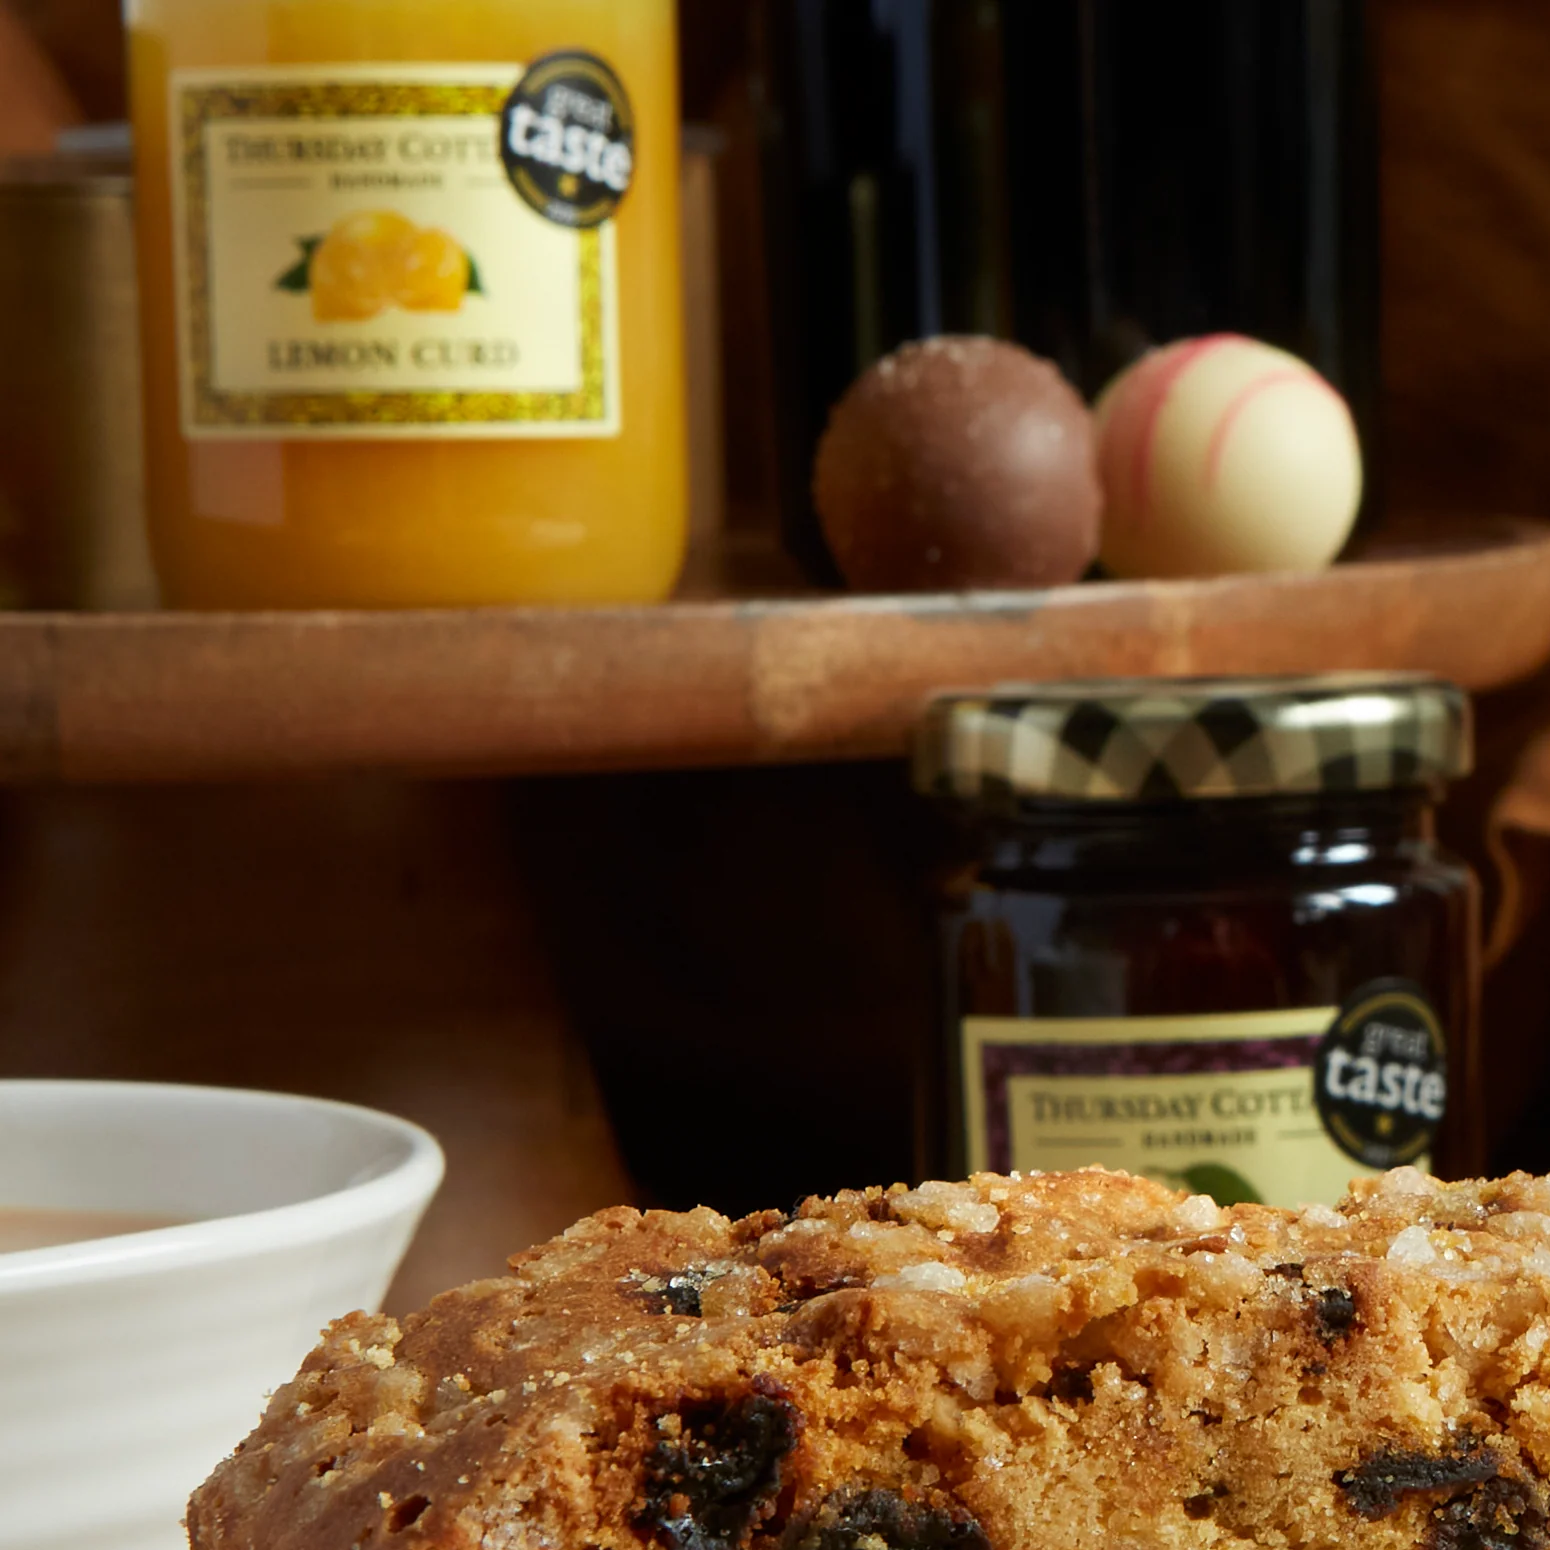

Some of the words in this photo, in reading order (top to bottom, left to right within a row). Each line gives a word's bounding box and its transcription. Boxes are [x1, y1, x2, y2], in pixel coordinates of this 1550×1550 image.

[508, 102, 631, 191] taste
[268, 339, 395, 374] LEMON
[411, 338, 520, 371] CURD
[1030, 1091, 1199, 1122] THURSDAY
[1326, 1047, 1445, 1120] taste
